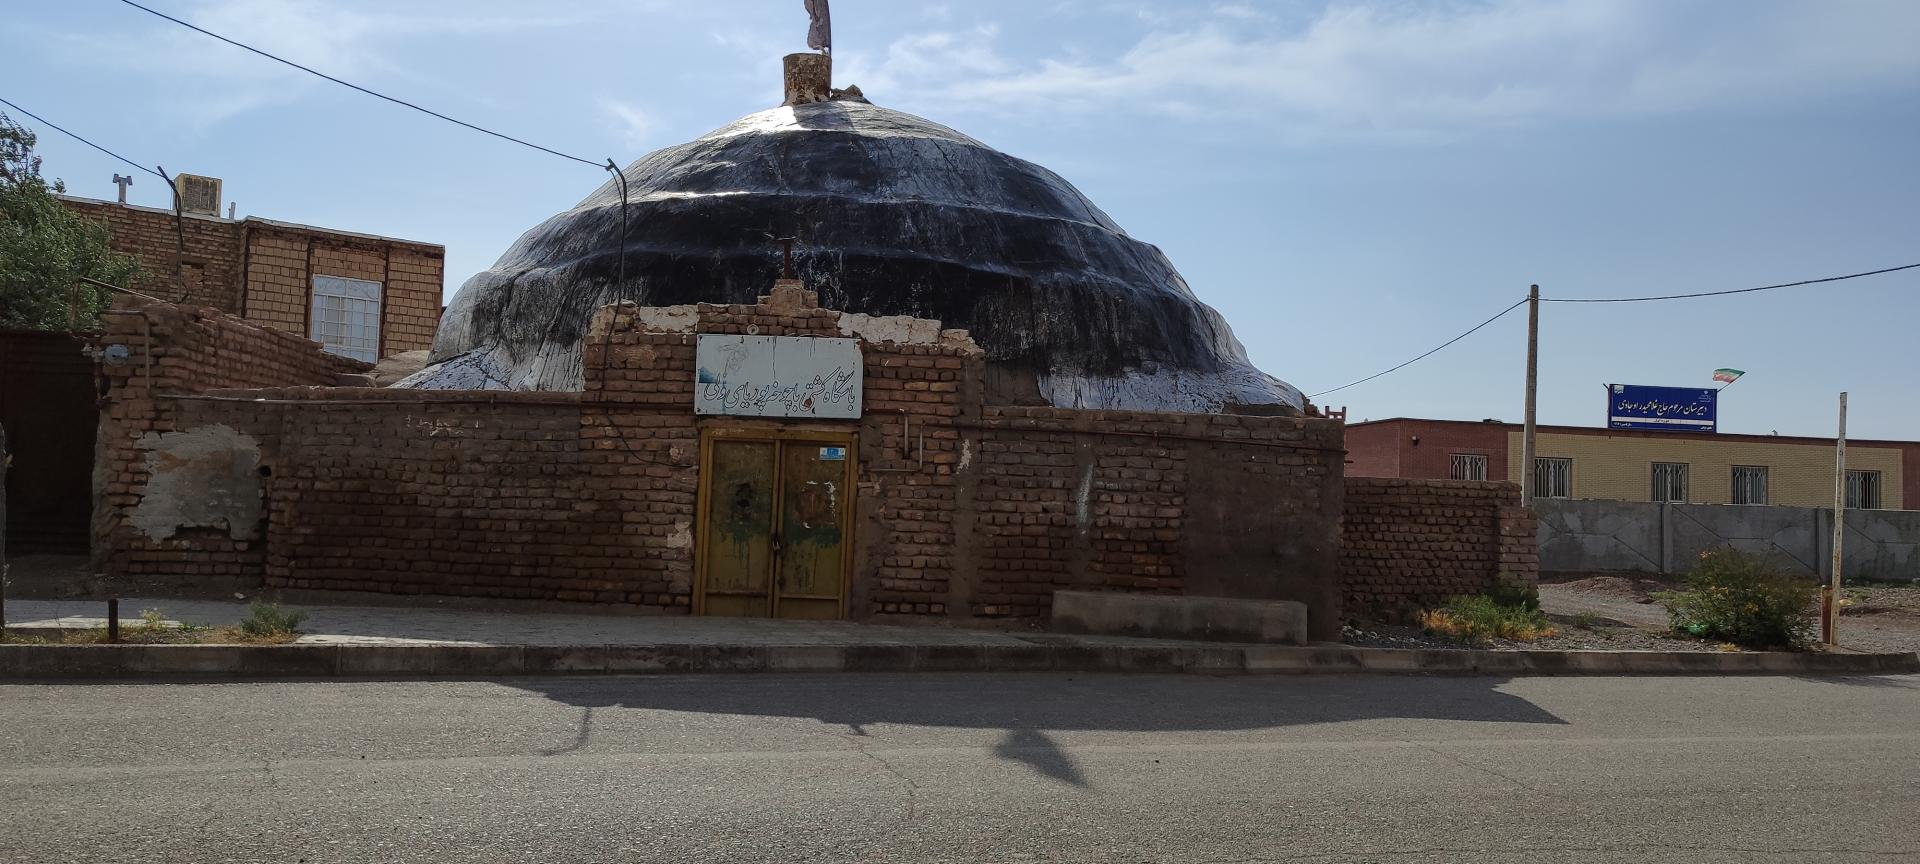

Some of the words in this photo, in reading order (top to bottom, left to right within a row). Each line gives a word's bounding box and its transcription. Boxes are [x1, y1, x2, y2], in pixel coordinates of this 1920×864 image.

[704, 373, 727, 401] ولی
[799, 366, 842, 412] کشتی
[823, 369, 856, 411] باشگاه
[1656, 402, 1668, 416] حاج
[1667, 403, 1683, 414] مرحوم
[1683, 402, 1707, 416] دبیرستان
